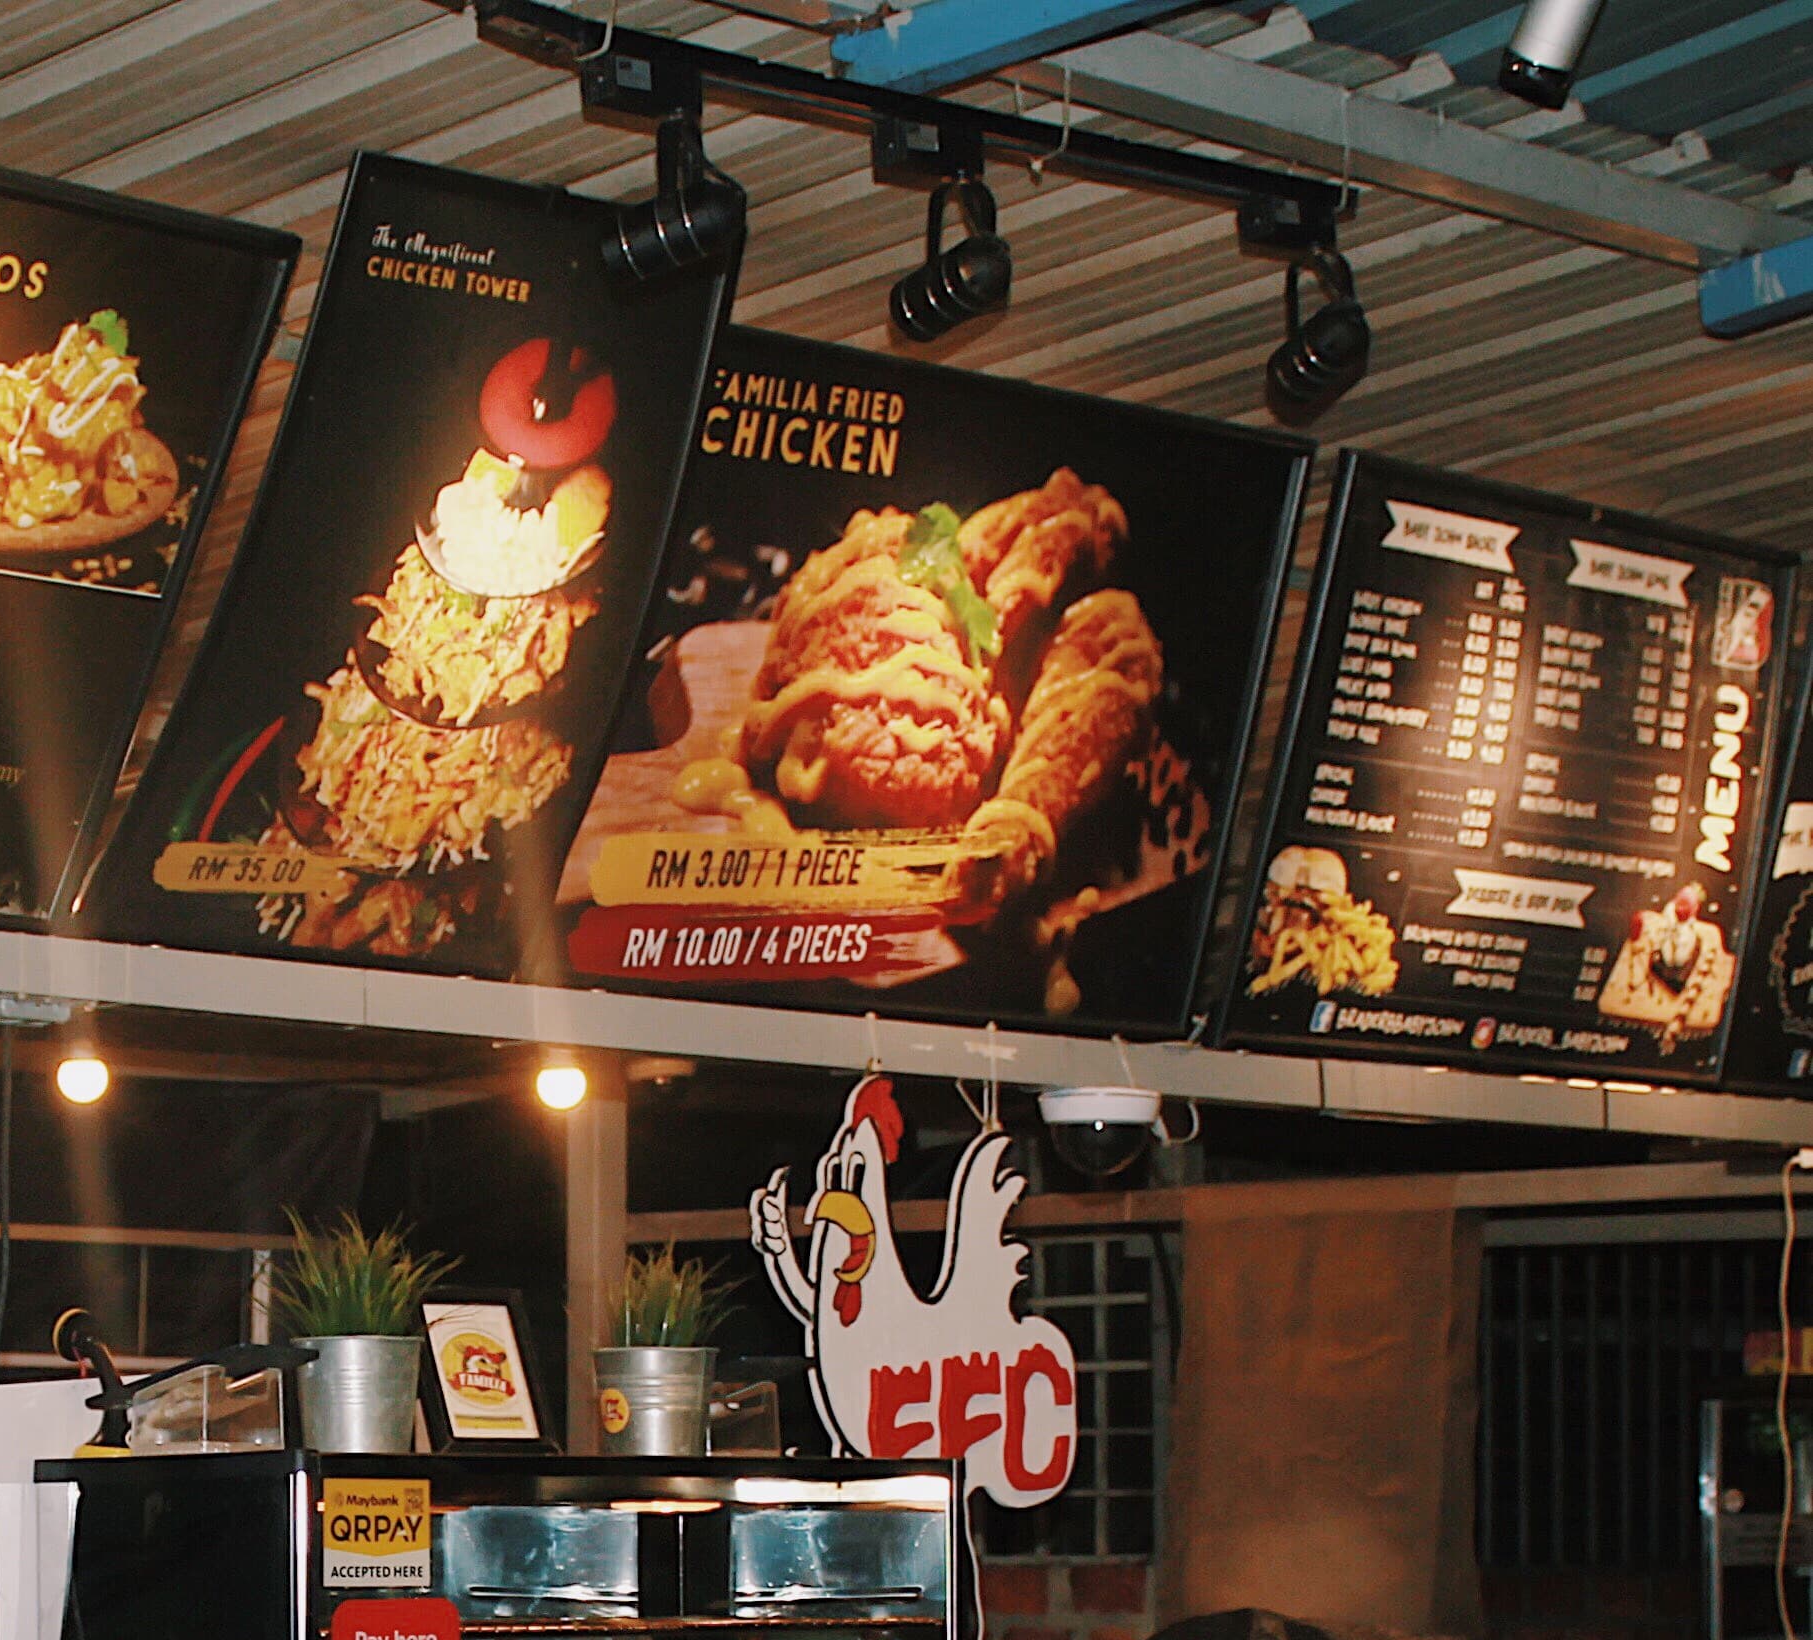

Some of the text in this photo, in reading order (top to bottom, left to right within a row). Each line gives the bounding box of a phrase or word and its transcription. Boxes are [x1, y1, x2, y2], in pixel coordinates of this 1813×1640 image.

[367, 254, 532, 303] CHICKEN TOWER
[828, 384, 906, 424] FRIED
[701, 405, 901, 477] CHICKEN
[1694, 684, 1750, 873] MENU
[188, 855, 307, 882] RM 35.00
[646, 847, 866, 889] RM 3.00 1 PIECE
[621, 923, 874, 969] RM 10.00 4 PIECES
[346, 1493, 399, 1508] Maybank
[330, 1514, 424, 1543] QRPAY
[330, 1565, 424, 1579] ACCEPTED HERE
